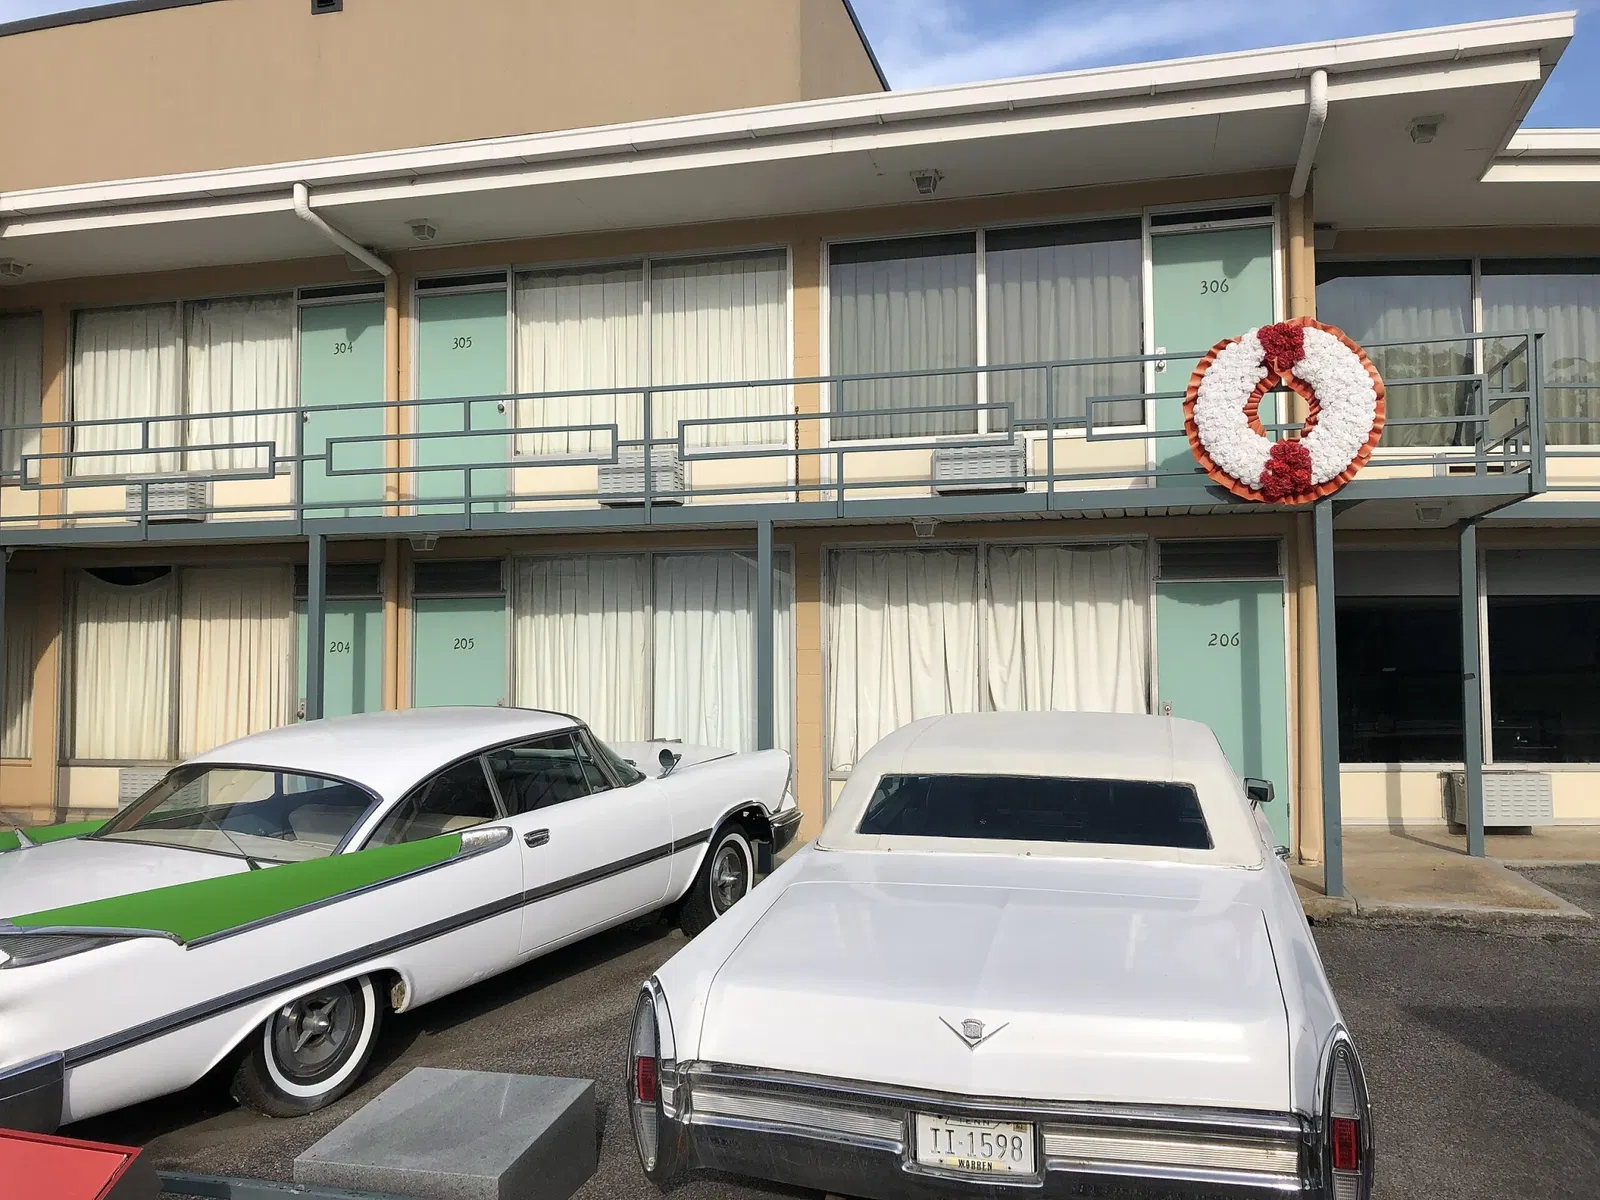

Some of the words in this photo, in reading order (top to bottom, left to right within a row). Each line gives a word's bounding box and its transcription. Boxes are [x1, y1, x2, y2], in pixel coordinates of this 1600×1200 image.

[1200, 278, 1229, 295] 306
[333, 342, 353, 355] 304
[452, 336, 472, 350] 305
[453, 638, 475, 650] 205
[1208, 632, 1240, 647] 206
[330, 641, 351, 654] 204
[957, 1159, 993, 1172] WARREN
